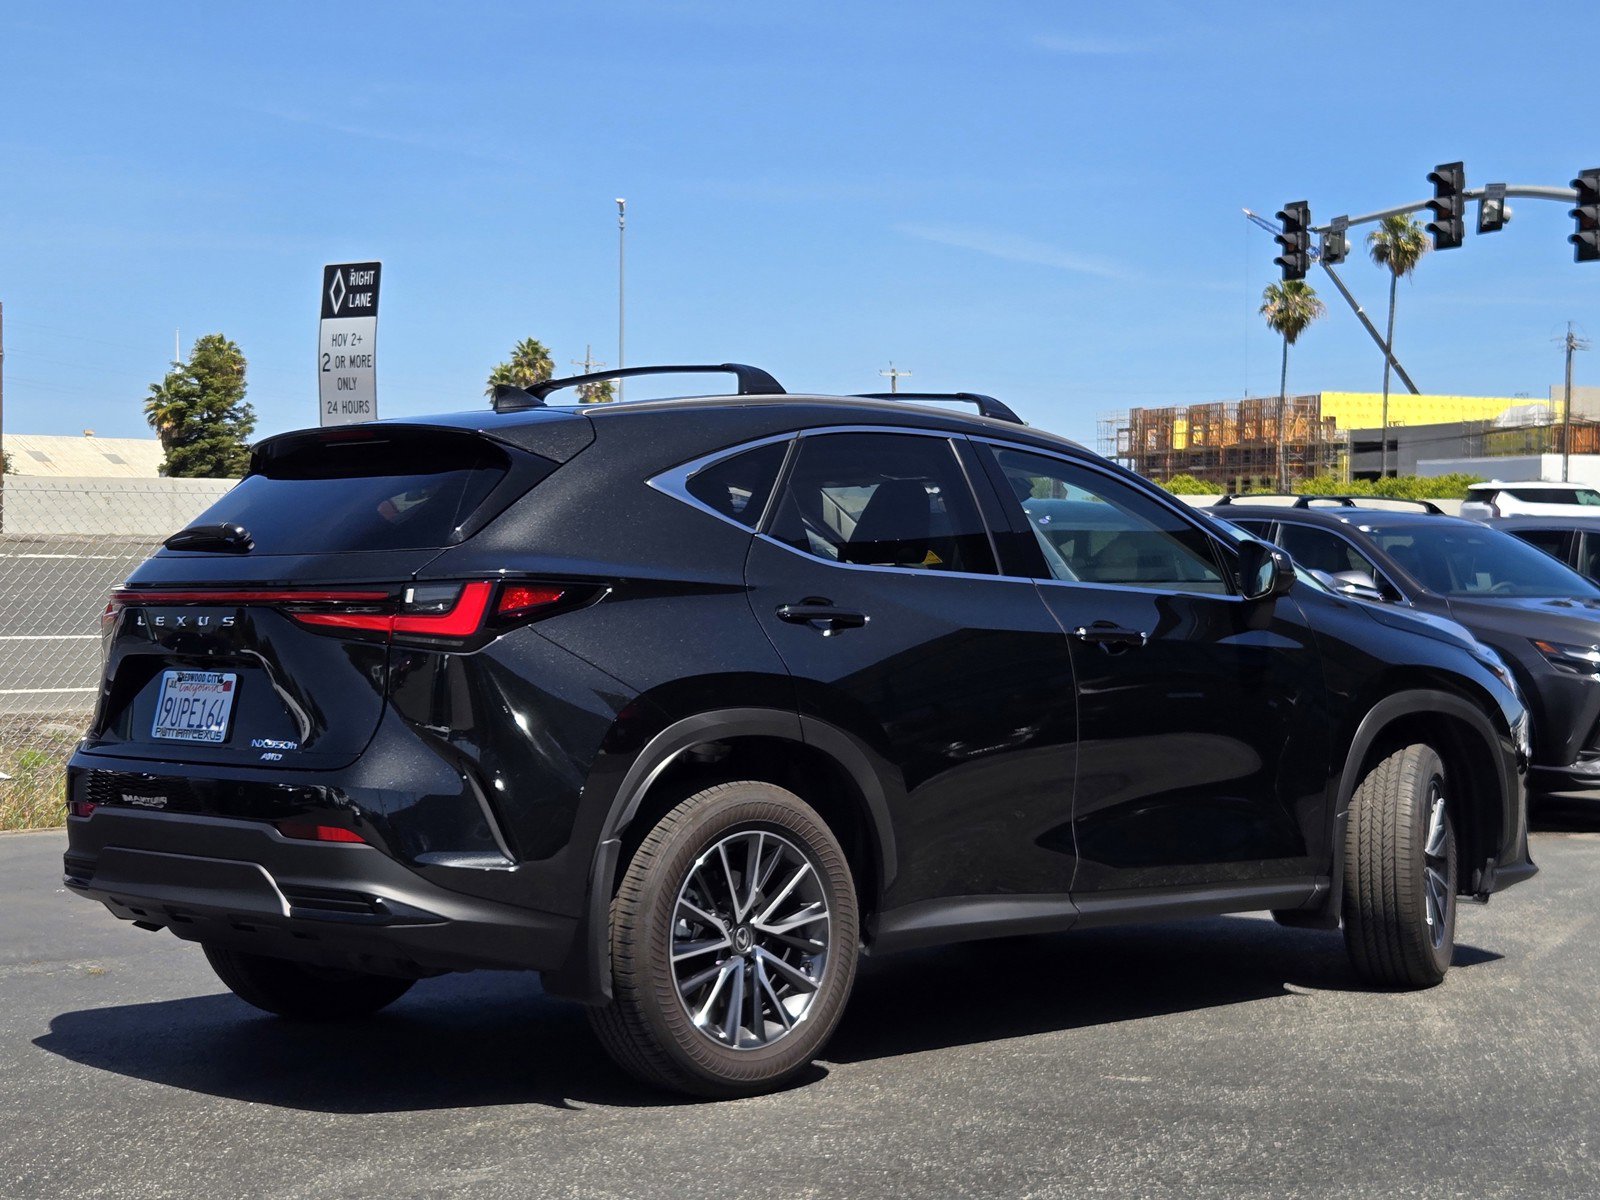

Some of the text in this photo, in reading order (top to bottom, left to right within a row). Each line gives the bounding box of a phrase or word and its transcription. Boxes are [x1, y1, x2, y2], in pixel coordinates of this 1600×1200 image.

[349, 270, 375, 286] RIGHT
[348, 292, 373, 308] LANE
[331, 332, 363, 348] HOV 2+
[322, 352, 373, 372] 2 OR MORE
[337, 377, 358, 391] ONLY
[327, 400, 370, 415] 24 HOURS
[137, 615, 235, 627] LEXUS
[160, 696, 225, 729] 9UPE164
[191, 730, 222, 741] LEXUS
